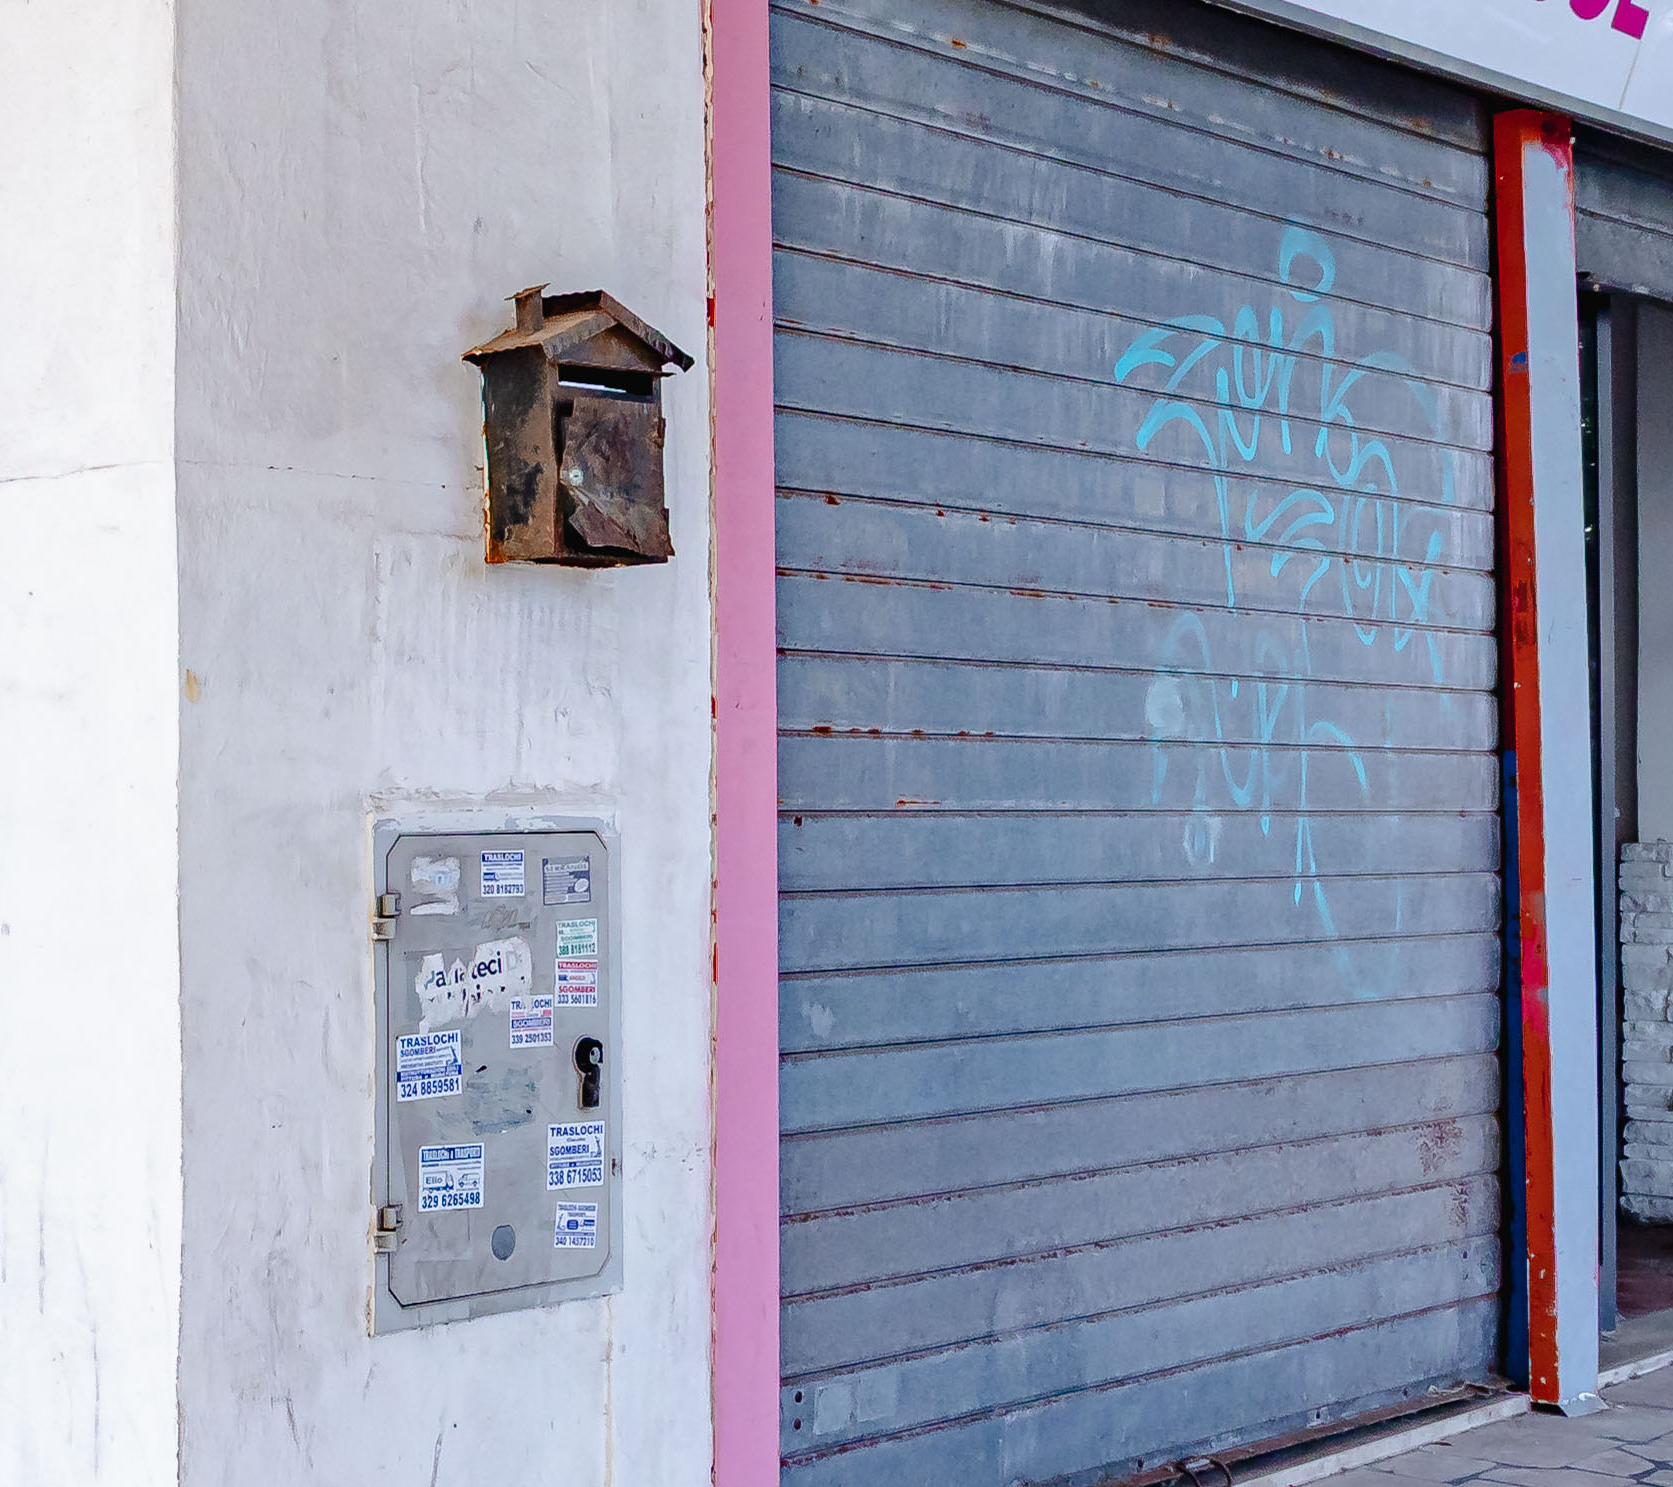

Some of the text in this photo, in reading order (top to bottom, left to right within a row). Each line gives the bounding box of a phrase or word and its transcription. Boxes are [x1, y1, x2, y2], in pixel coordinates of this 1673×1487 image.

[557, 919, 596, 928] TRASLOCHI
[558, 985, 596, 993] SGOMBERI
[511, 999, 553, 1010] TROCHI
[400, 1032, 459, 1048] TRASLOCHI
[511, 1034, 523, 1044] 339
[400, 1046, 436, 1057] SGOMBERI
[400, 1077, 460, 1098] 324 8859581
[550, 1124, 603, 1137] TRASLOCHI
[549, 1144, 590, 1156] SGOMBERI
[548, 1167, 603, 1186] 338 6715053
[421, 1191, 481, 1209] 329 6265498
